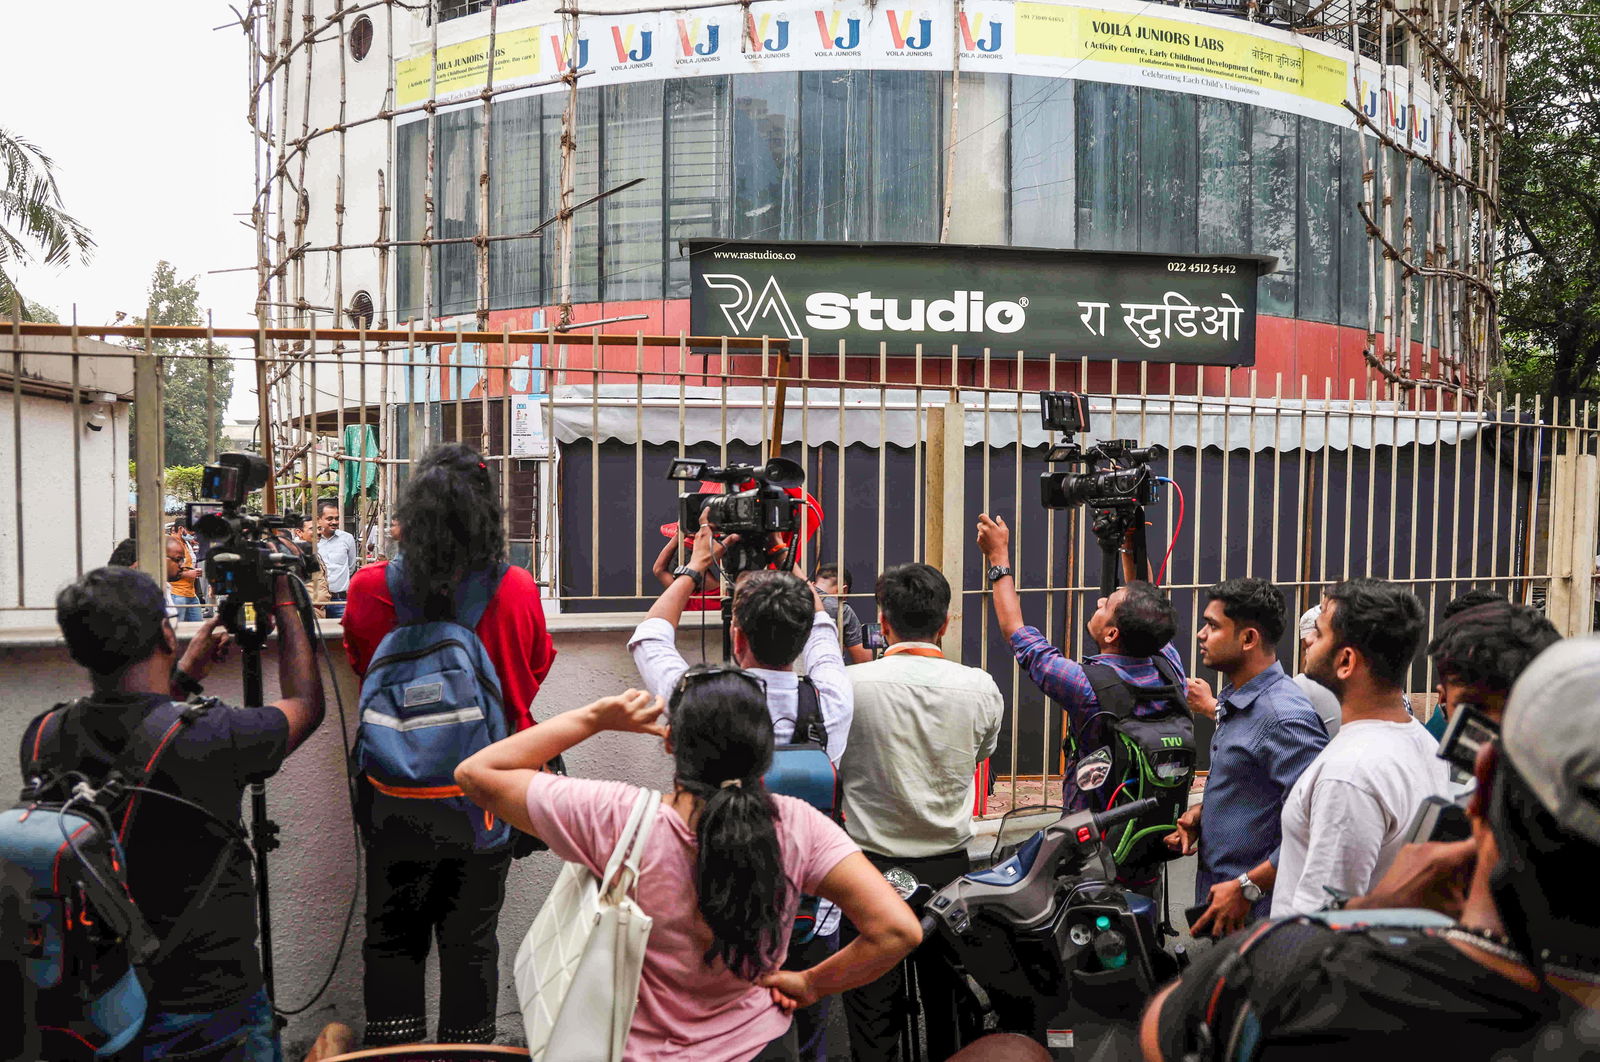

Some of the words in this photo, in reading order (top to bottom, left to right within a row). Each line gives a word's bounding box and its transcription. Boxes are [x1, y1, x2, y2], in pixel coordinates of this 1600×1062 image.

[1092, 20, 1132, 37] VOILA
[1135, 26, 1190, 46] JUNIORS
[1194, 35, 1225, 52] LABS
[436, 60, 453, 71] OILA
[454, 52, 484, 67] JUNIORS
[628, 62, 654, 70] JUNIORS
[694, 56, 721, 64] JUNIORS
[1149, 49, 1168, 59] Early
[1169, 52, 1205, 64] Childhood
[1206, 57, 1249, 72] Development
[1142, 69, 1181, 83] Celebrating
[1183, 74, 1200, 83] Each
[1225, 81, 1260, 96] Uniqueness
[713, 250, 796, 260] www.rastudios.co
[1167, 262, 1186, 272] 022
[1188, 263, 1210, 273] 4512
[1212, 264, 1237, 274] 5442
[702, 273, 804, 339] RA
[1077, 301, 1111, 337] रा
[1120, 291, 1245, 349] स्टुडिओ
[1161, 737, 1183, 747] TVU
